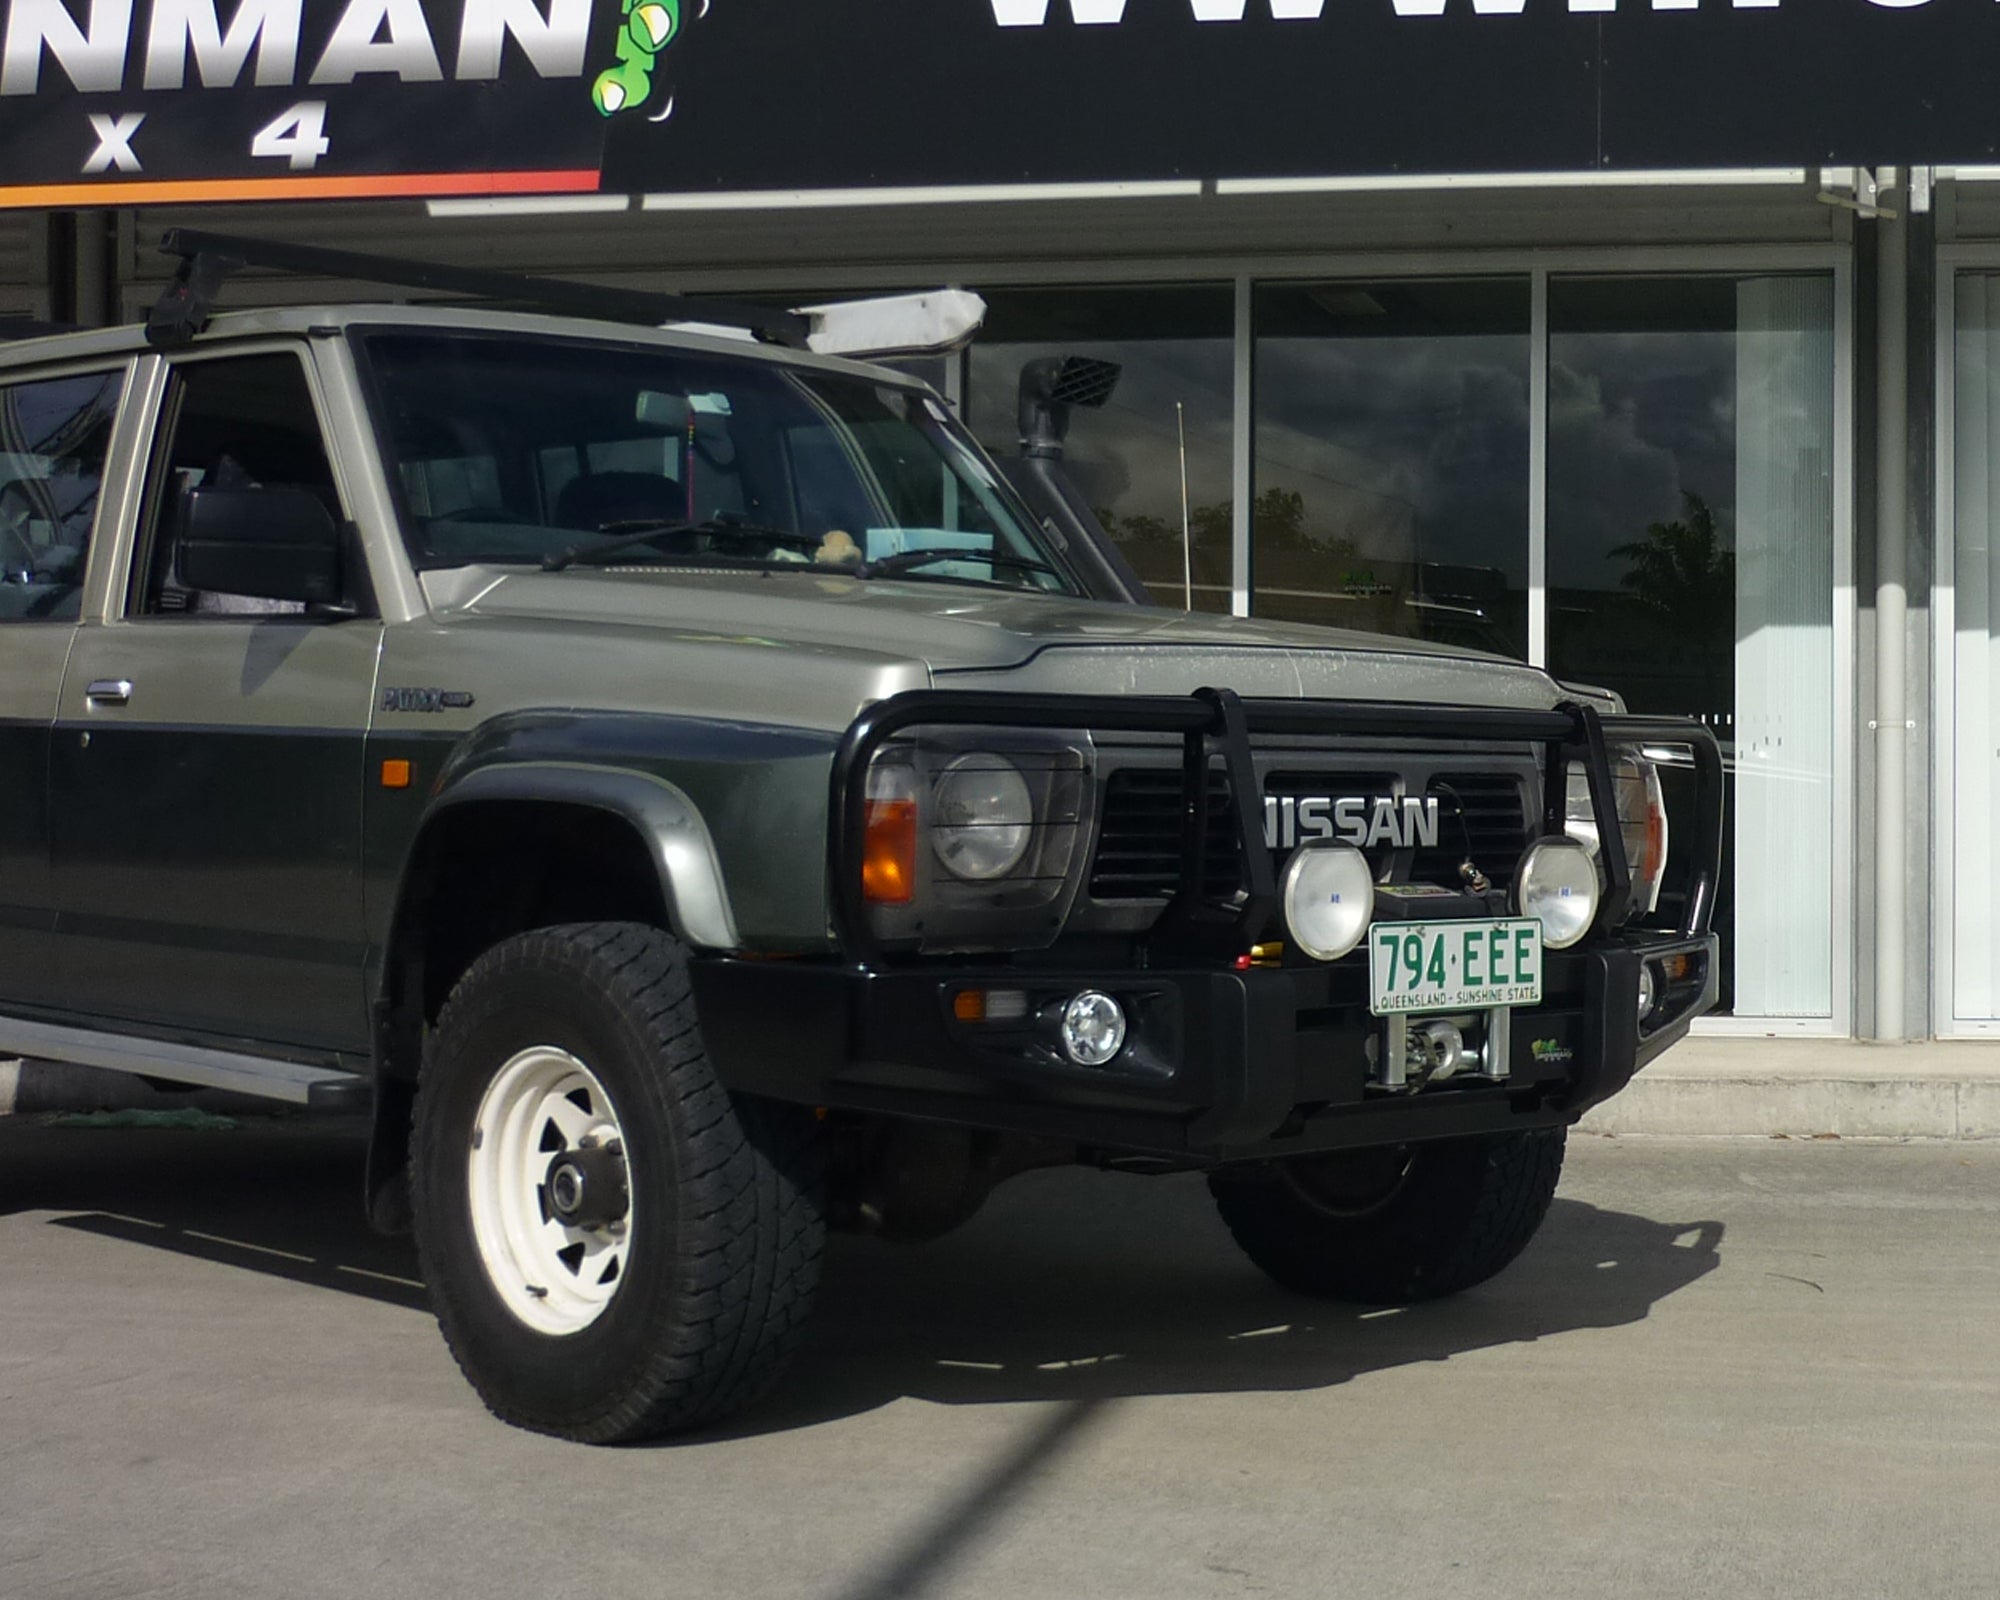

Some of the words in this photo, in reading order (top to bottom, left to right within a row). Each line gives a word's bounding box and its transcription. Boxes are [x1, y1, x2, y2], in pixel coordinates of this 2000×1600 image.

[251, 101, 330, 169] 4
[1381, 992, 1446, 1009] QUEENSLAND
[1457, 988, 1502, 1003] SUNSHINE
[1508, 986, 1535, 1000] STATE
